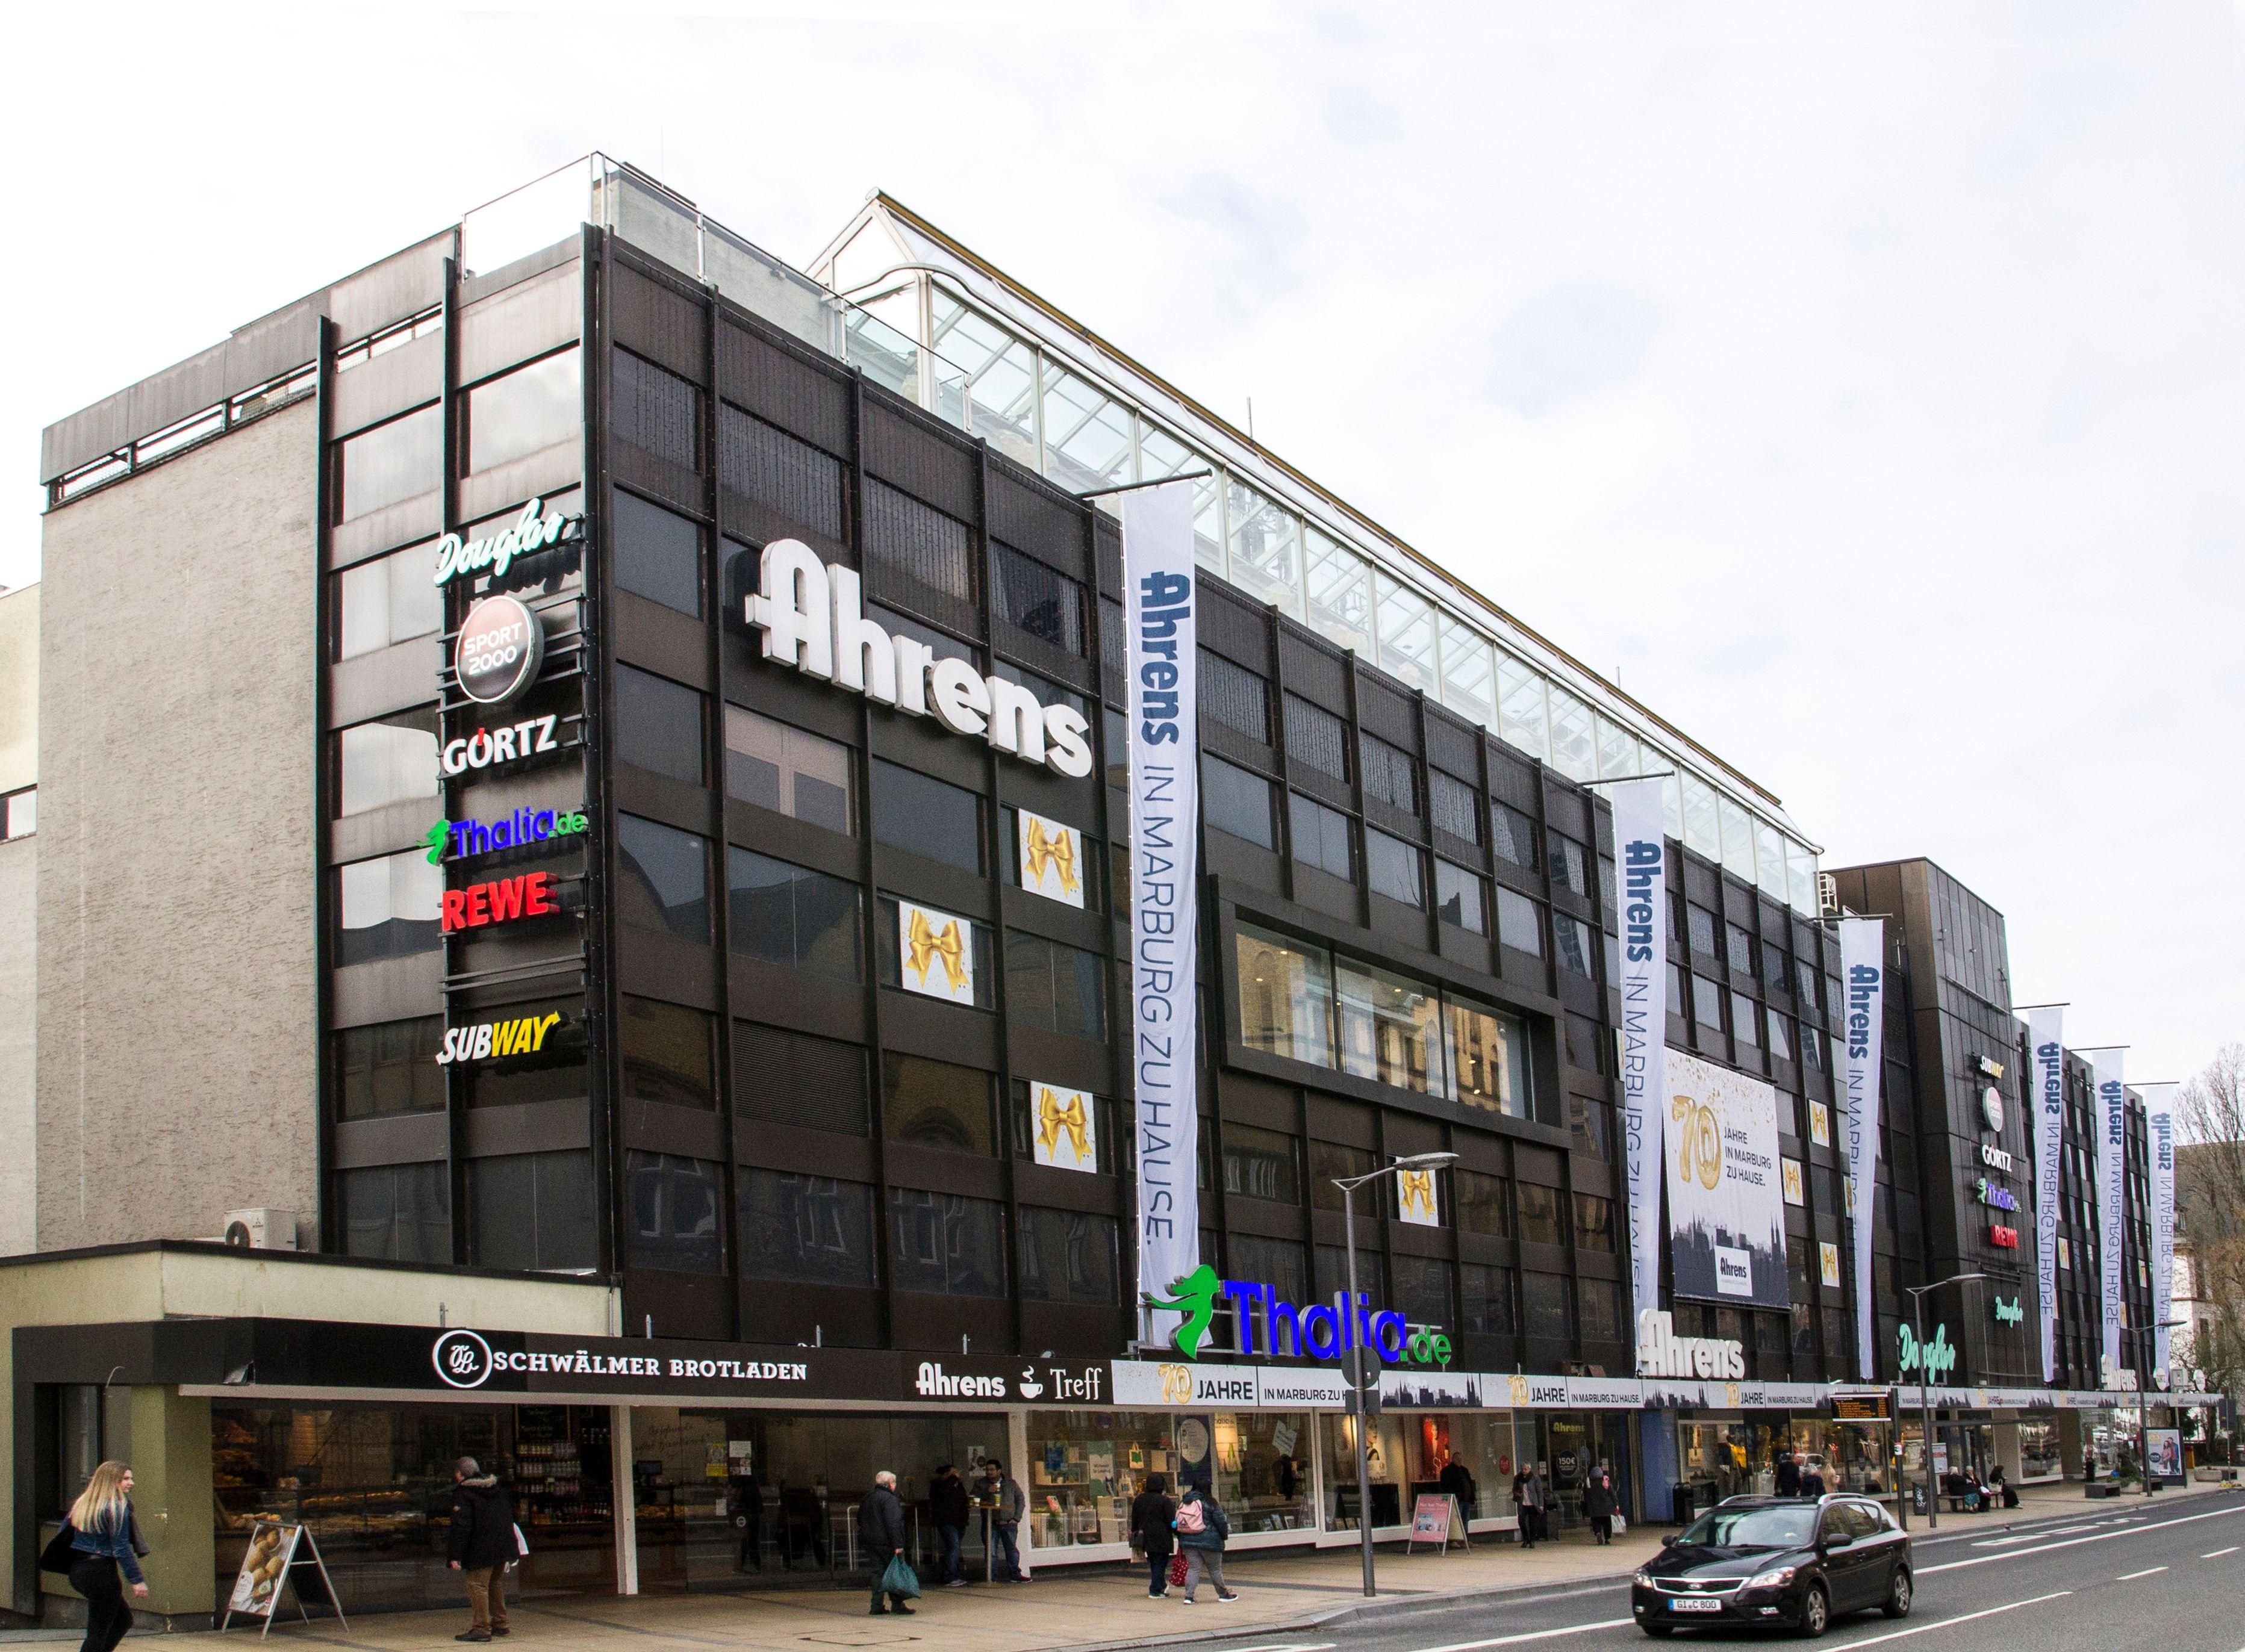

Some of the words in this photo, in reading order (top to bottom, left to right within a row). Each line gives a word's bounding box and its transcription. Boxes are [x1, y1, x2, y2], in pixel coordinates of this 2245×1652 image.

[434, 498, 565, 584] Douglas
[463, 621, 523, 656] SPORT
[469, 645, 517, 675] 2000
[745, 538, 1092, 778] Ahrens
[1141, 571, 1191, 746] Ahrens
[1144, 766, 1174, 803] IN
[441, 871, 550, 933] REWE
[1140, 816, 1174, 1023] MARBURG
[1625, 840, 1661, 963] Ahrens
[1626, 977, 1648, 1002] IN
[1849, 964, 1879, 1060] Ahrens
[435, 1010, 561, 1066] SUBWAY
[1140, 1036, 1172, 1088] ZU
[1625, 1010, 1648, 1151] MARBURG
[1849, 1070, 1864, 1092] IN
[1672, 1095, 1721, 1190] 70
[1724, 1126, 1748, 1144] JAHRE
[1725, 1146, 1733, 1160] IN
[1734, 1148, 1772, 1169] MARBURG
[1727, 1165, 1737, 1179] ZU
[1739, 1168, 1766, 1187] HAUSE.
[1994, 1225, 2019, 1250] REWE
[1720, 1256, 1747, 1278] Ahrens
[1637, 1308, 1745, 1379] Ahrens
[668, 1358, 807, 1380] BROTLADEN
[915, 1362, 1006, 1397] Ahrens
[1050, 1367, 1103, 1400] Treff
[1158, 1363, 1193, 1404] 70
[1197, 1379, 1254, 1400] JAHRE
[1264, 1388, 1275, 1400] IN
[1277, 1388, 1326, 1400] MARBURG
[1328, 1390, 1340, 1400] ZU
[1507, 1374, 1528, 1406] 70
[1531, 1387, 1566, 1402] JAHRE
[1571, 1394, 1578, 1403] IN
[1580, 1394, 1610, 1403] MARBURG
[1611, 1394, 1619, 1403] ZU
[1619, 1394, 1641, 1403] HAUSE.
[1725, 1382, 1739, 1408] 70
[1741, 1392, 1764, 1405] JAHRE
[1553, 1421, 1586, 1432] Ahrens
